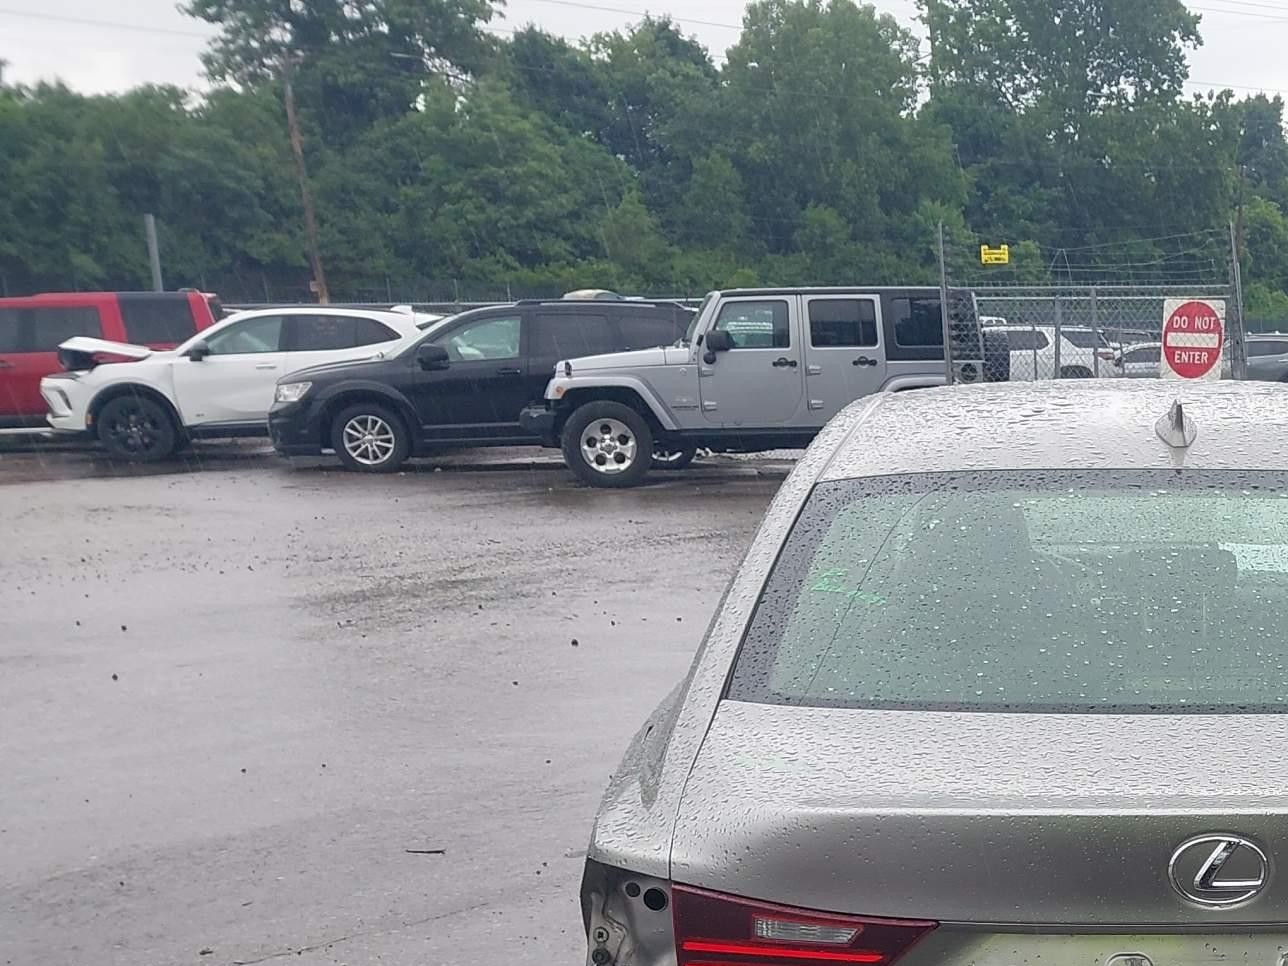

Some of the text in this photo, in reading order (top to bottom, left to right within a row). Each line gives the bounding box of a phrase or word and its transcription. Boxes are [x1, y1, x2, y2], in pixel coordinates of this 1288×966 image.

[1174, 316, 1216, 330] DO NOT
[1174, 351, 1209, 364] ENTER
